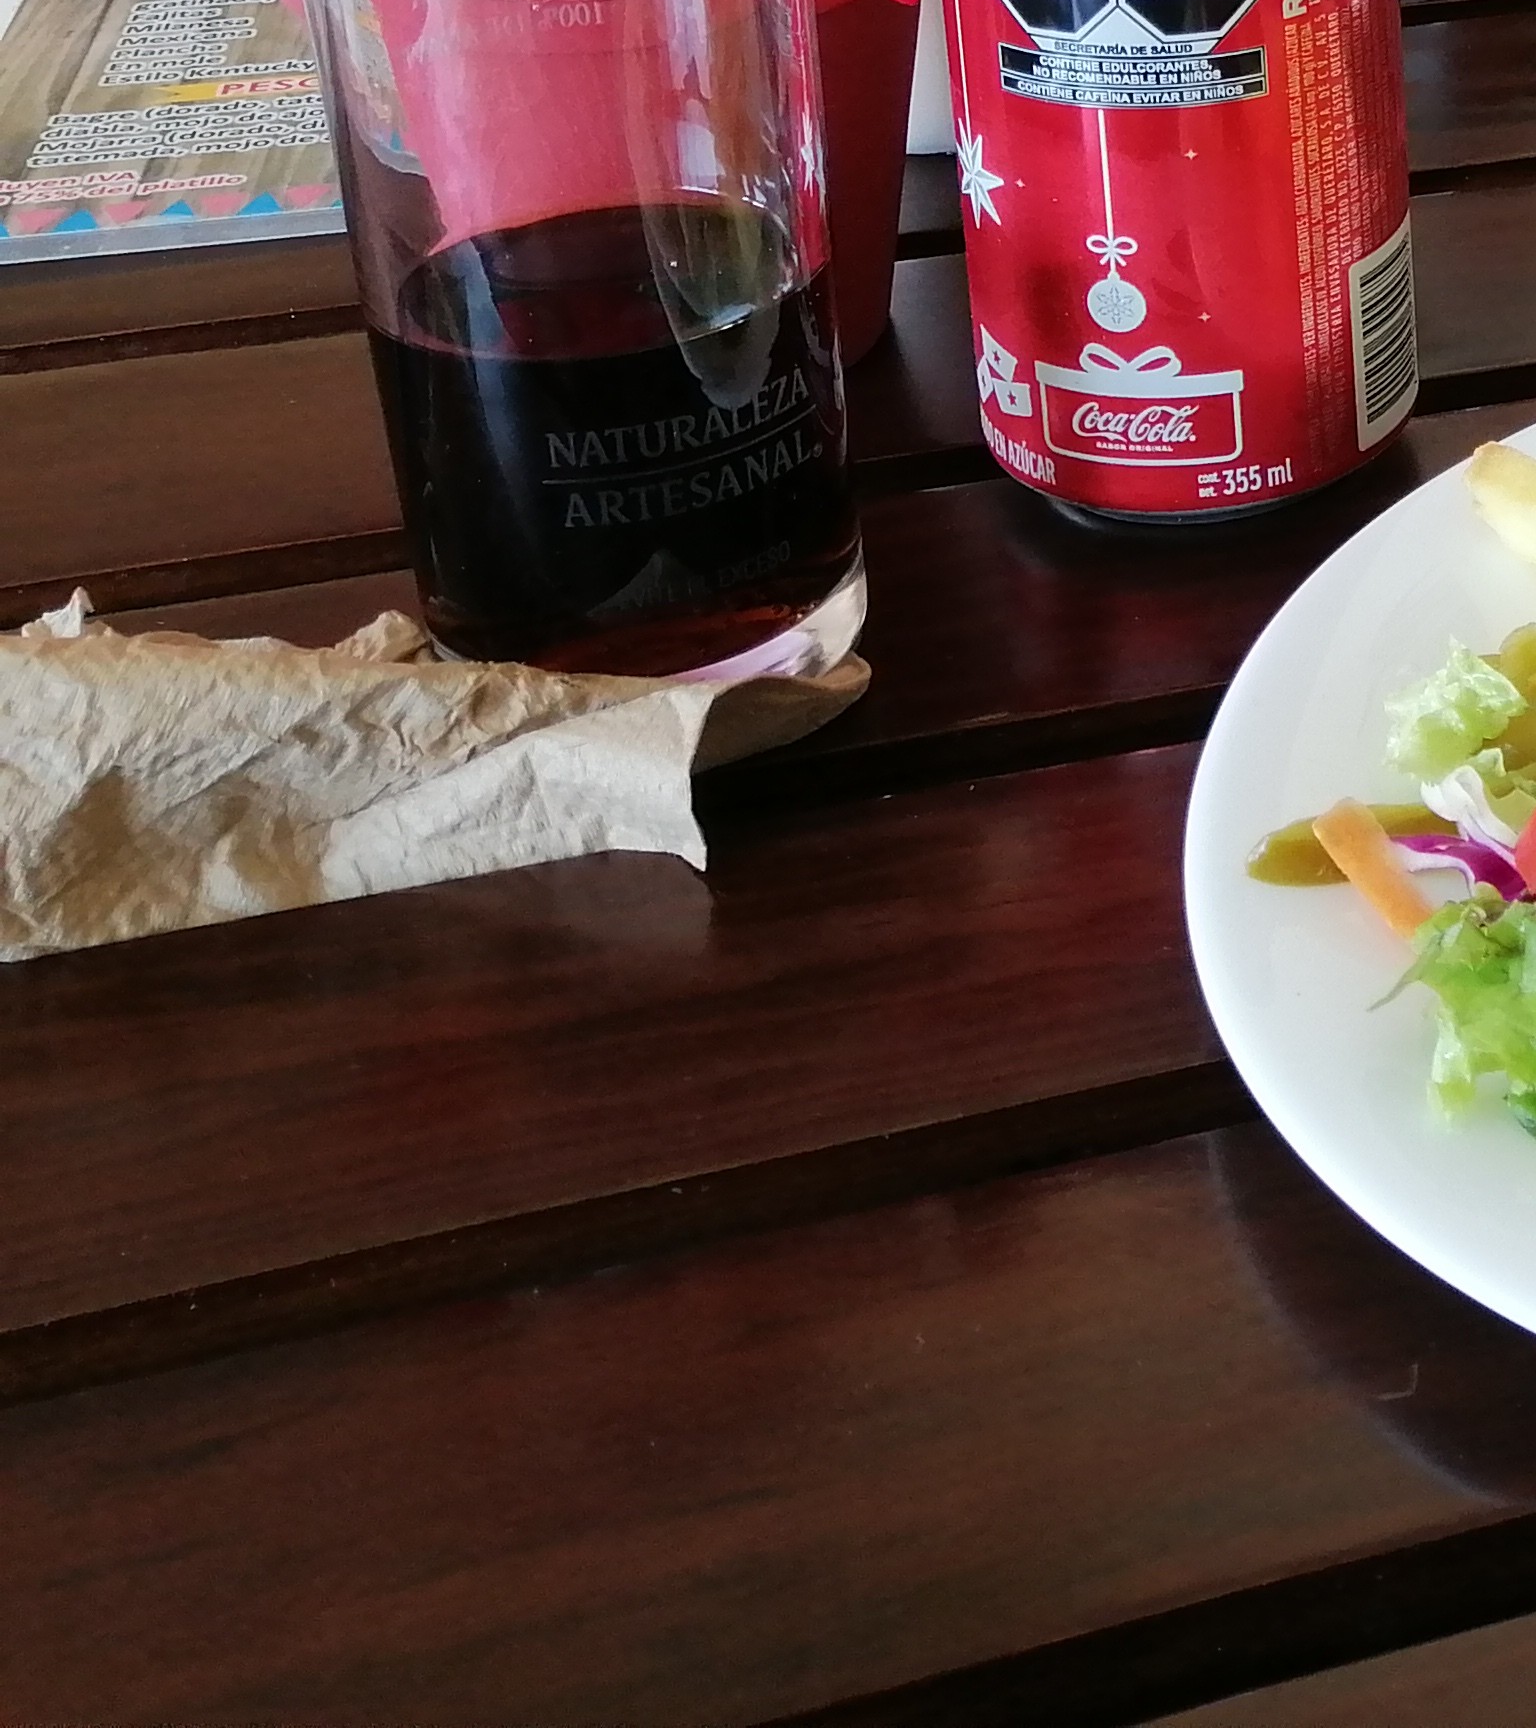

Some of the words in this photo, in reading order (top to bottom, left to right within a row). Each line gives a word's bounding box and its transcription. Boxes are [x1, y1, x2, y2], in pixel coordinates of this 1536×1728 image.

[131, 8, 218, 23] Fajitas
[126, 18, 249, 35] Milanesa
[119, 29, 252, 47] Mexicana
[113, 43, 223, 60] Plancha
[1054, 41, 1127, 56] SECRETARÍA
[1130, 46, 1147, 55] DE
[1150, 44, 1193, 55] SALUD
[103, 71, 179, 86] Estilo
[188, 60, 316, 79] Kentucky
[109, 62, 141, 73] En
[152, 55, 222, 70] mole
[1039, 55, 1100, 73] CONTIENE
[1102, 59, 1213, 74] EDULCORANTES,
[1032, 64, 1050, 78] NO
[1051, 68, 1157, 86] RECOMENDABLE
[1160, 73, 1178, 84] EN
[1181, 69, 1222, 84] NIÑOS
[221, 76, 320, 97] PESC
[1017, 80, 1074, 100] CONTIENE
[1075, 89, 1131, 104] CAFEÍNA
[1133, 92, 1180, 104] EVITAR
[1183, 89, 1202, 101] EN
[1204, 85, 1245, 100] NIÑOS
[238, 111, 272, 122] de
[280, 135, 314, 146] de
[545, 368, 810, 469] NATURALEZA
[1008, 439, 1056, 485] AZÚCAR
[564, 430, 812, 528] ARTESANAL
[1222, 465, 1262, 495] 355
[1267, 457, 1293, 487] ml
